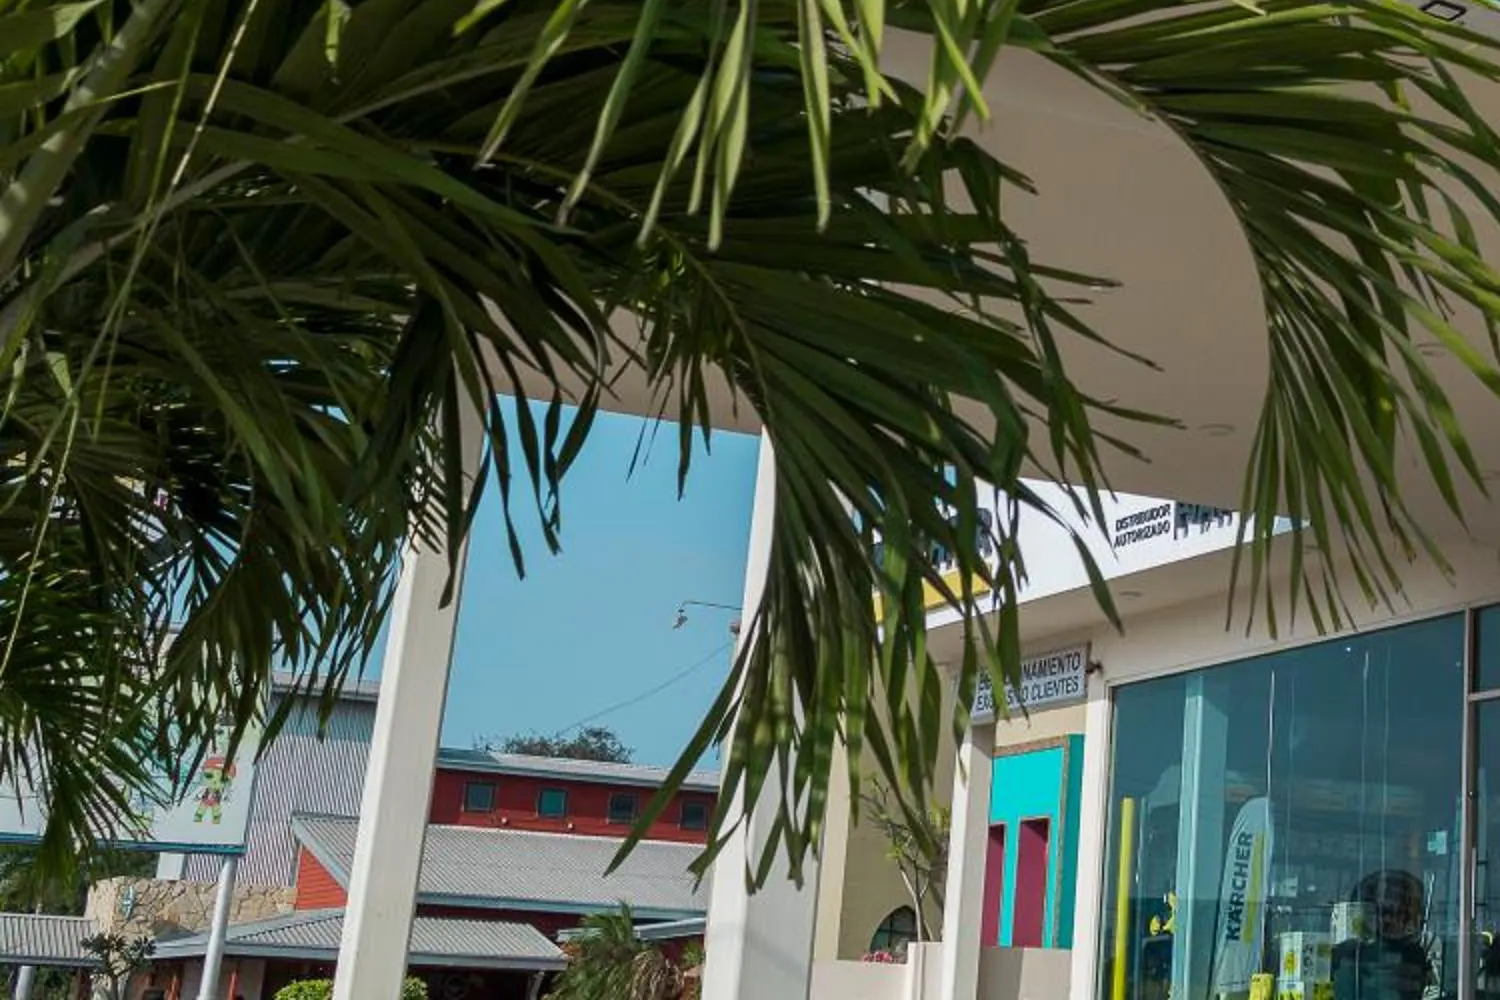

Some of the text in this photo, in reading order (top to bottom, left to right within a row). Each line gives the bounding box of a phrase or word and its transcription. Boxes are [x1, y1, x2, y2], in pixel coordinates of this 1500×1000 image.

[1115, 504, 1171, 532] DISTRIBUIDOR
[1114, 520, 1171, 548] AUTORIZADO
[1031, 676, 1079, 701] CLIENTES
